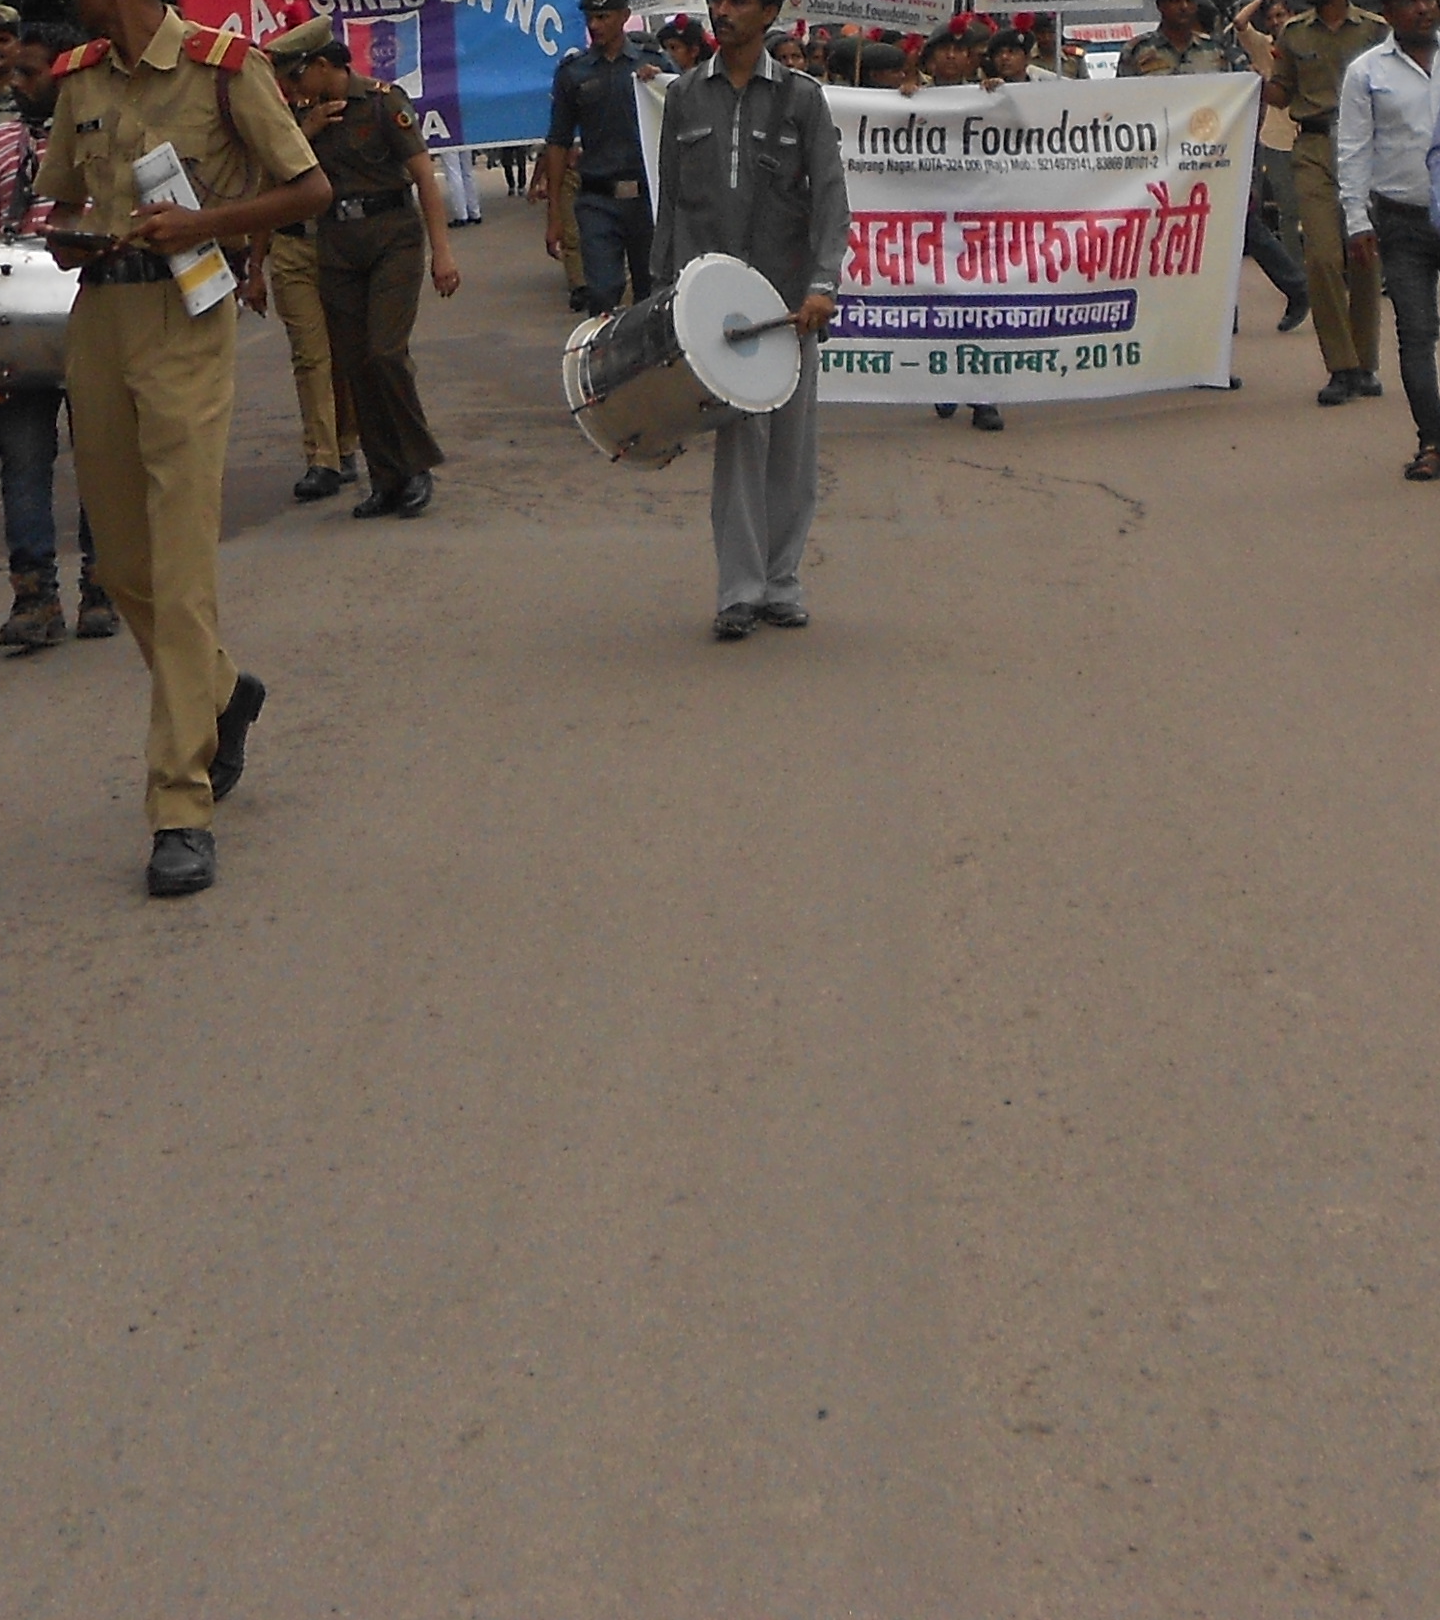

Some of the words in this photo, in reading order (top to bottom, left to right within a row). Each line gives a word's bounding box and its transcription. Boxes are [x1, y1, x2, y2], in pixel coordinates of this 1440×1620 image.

[865, 2, 921, 22] Foundation
[858, 113, 947, 156] India
[962, 109, 1157, 157] Foundation
[1180, 142, 1228, 158] Rotary
[841, 211, 947, 286] त्रदान
[1146, 180, 1212, 277] रैली
[847, 298, 929, 329] नेत्रदान
[928, 349, 949, 375] 8
[954, 343, 1069, 378] सितम्बर,
[1076, 341, 1141, 371] 2016
